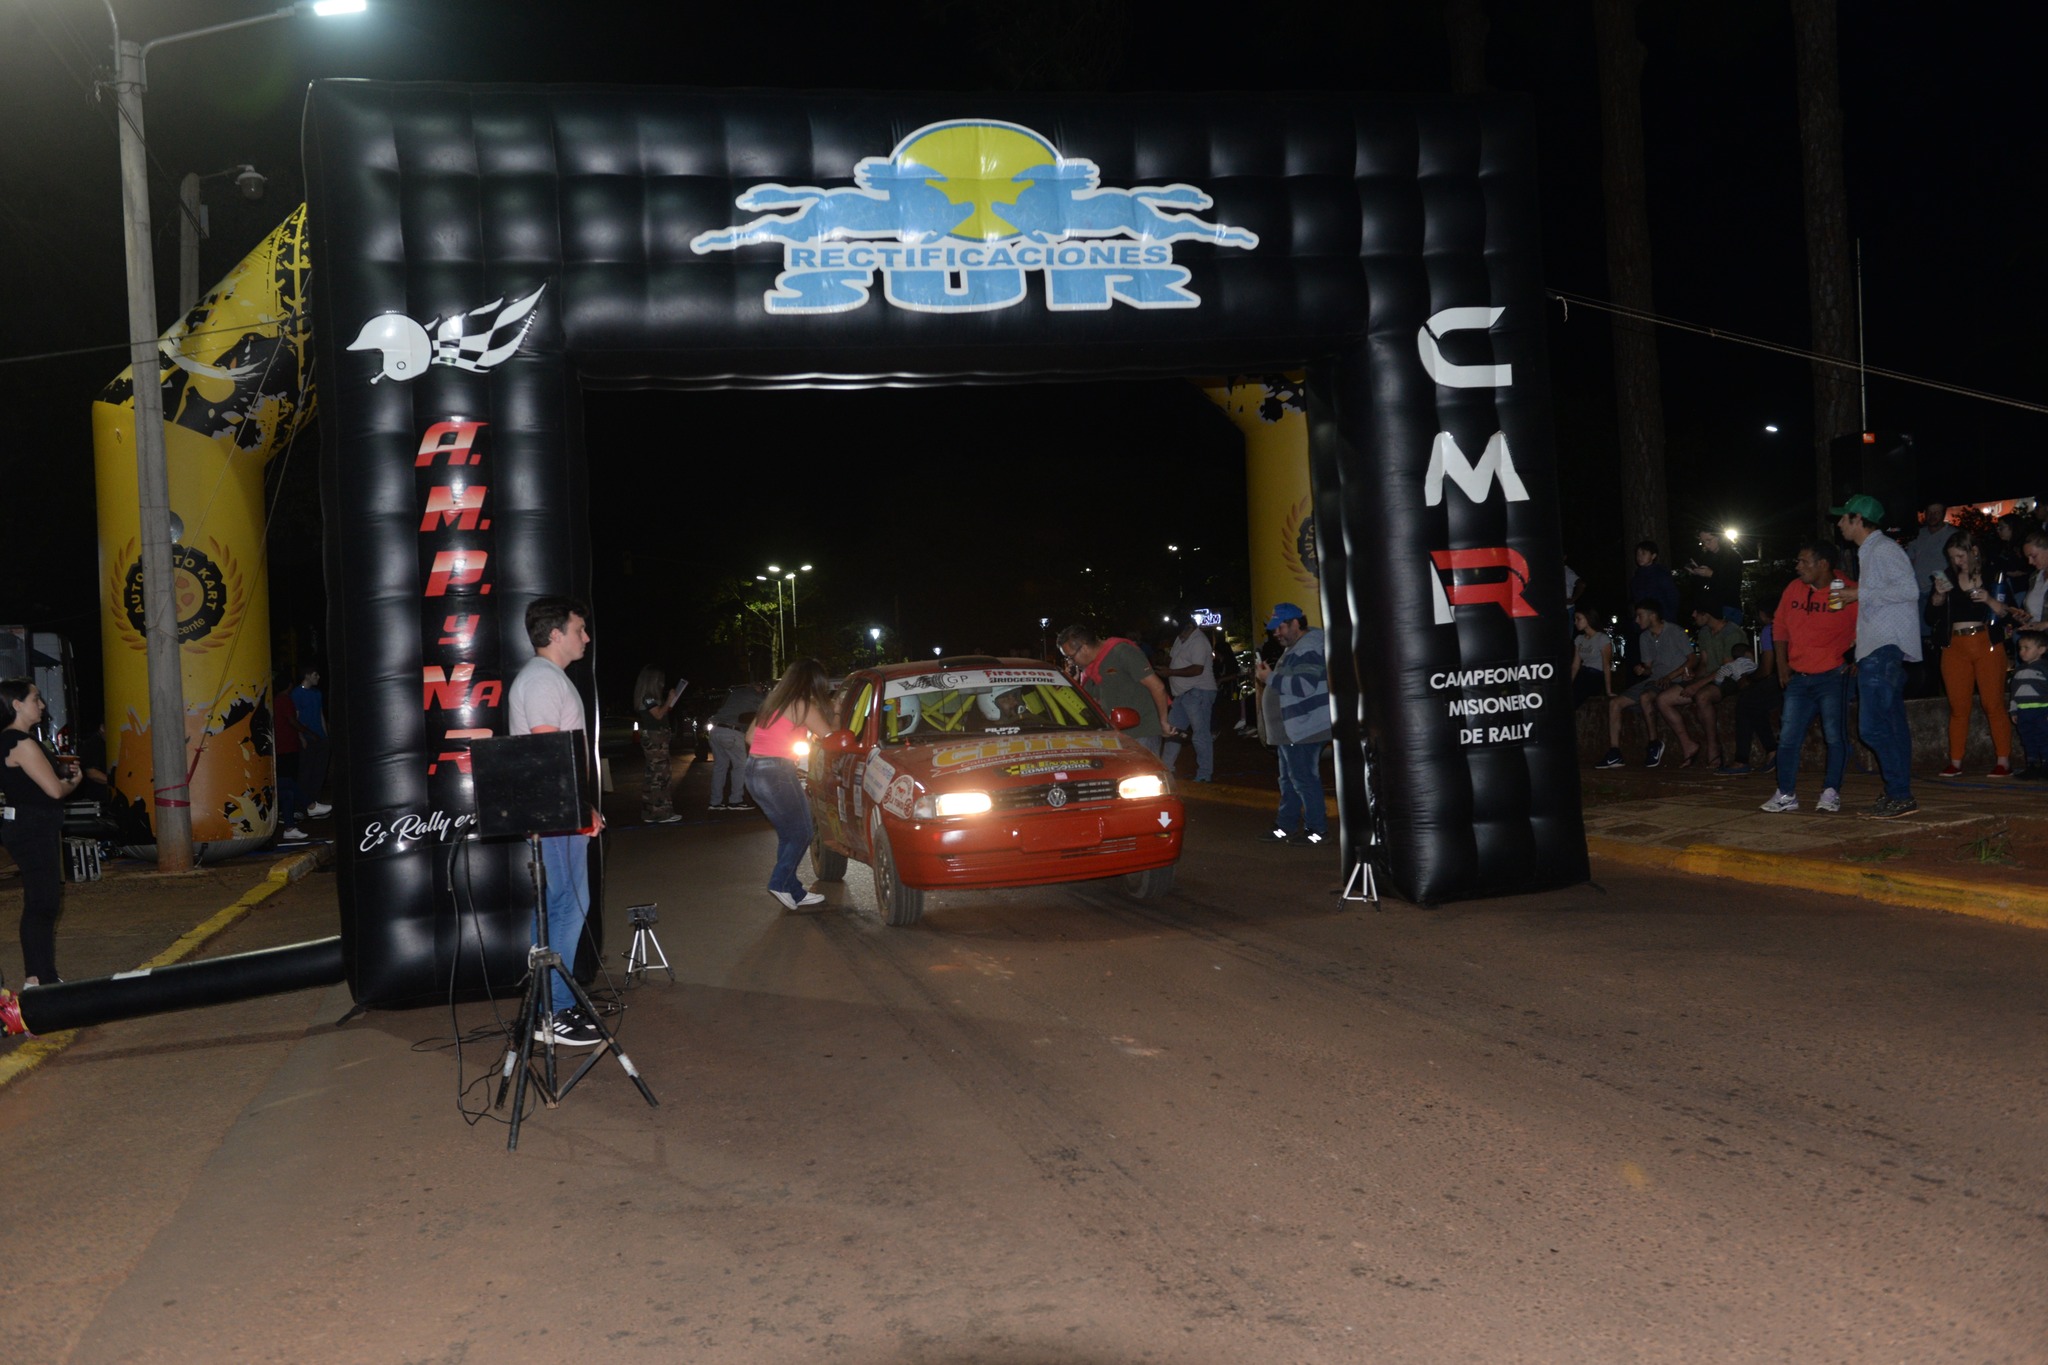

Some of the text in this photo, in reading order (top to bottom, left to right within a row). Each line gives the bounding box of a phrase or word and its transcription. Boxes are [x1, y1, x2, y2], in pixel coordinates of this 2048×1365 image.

[790, 244, 1169, 268] RECTIFICACIONES
[766, 268, 1200, 314] SUR
[197, 567, 219, 611] KART
[983, 669, 1054, 678] Firestone
[988, 676, 1056, 684] BRIDGESTONE
[1429, 662, 1554, 690] CAMPEONATO
[1448, 692, 1543, 717] MISIONERO
[1459, 722, 1534, 745] DE RALLY
[359, 821, 389, 852] Es
[390, 810, 452, 842] Rally
